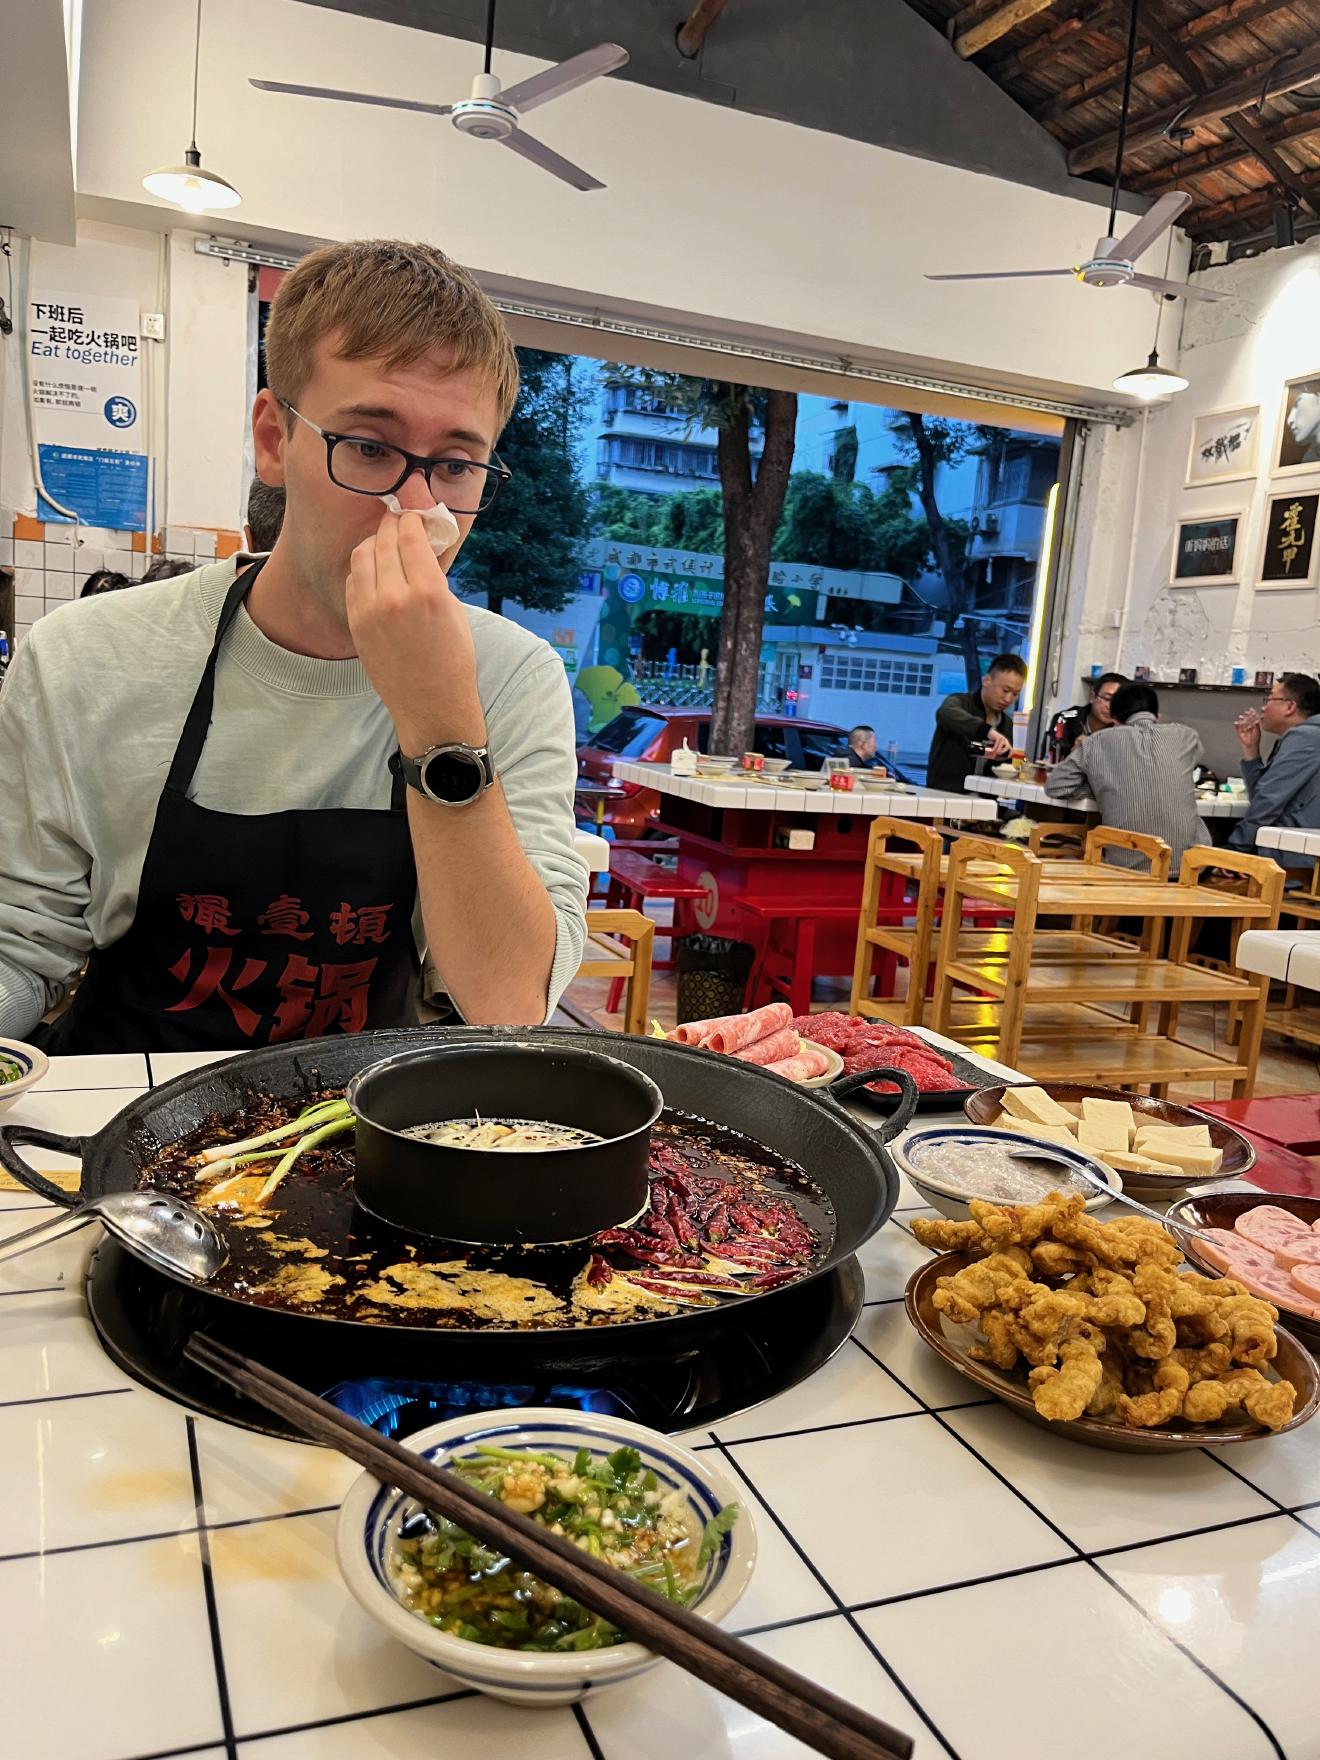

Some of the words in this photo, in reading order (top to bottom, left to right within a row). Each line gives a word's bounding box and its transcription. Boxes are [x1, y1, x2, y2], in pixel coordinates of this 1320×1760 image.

[31, 302, 84, 325] 下班后
[30, 325, 138, 352] 一起吃火锅吧
[32, 341, 60, 358] Eat
[66, 345, 138, 367] together
[164, 946, 380, 1043] 火锅
